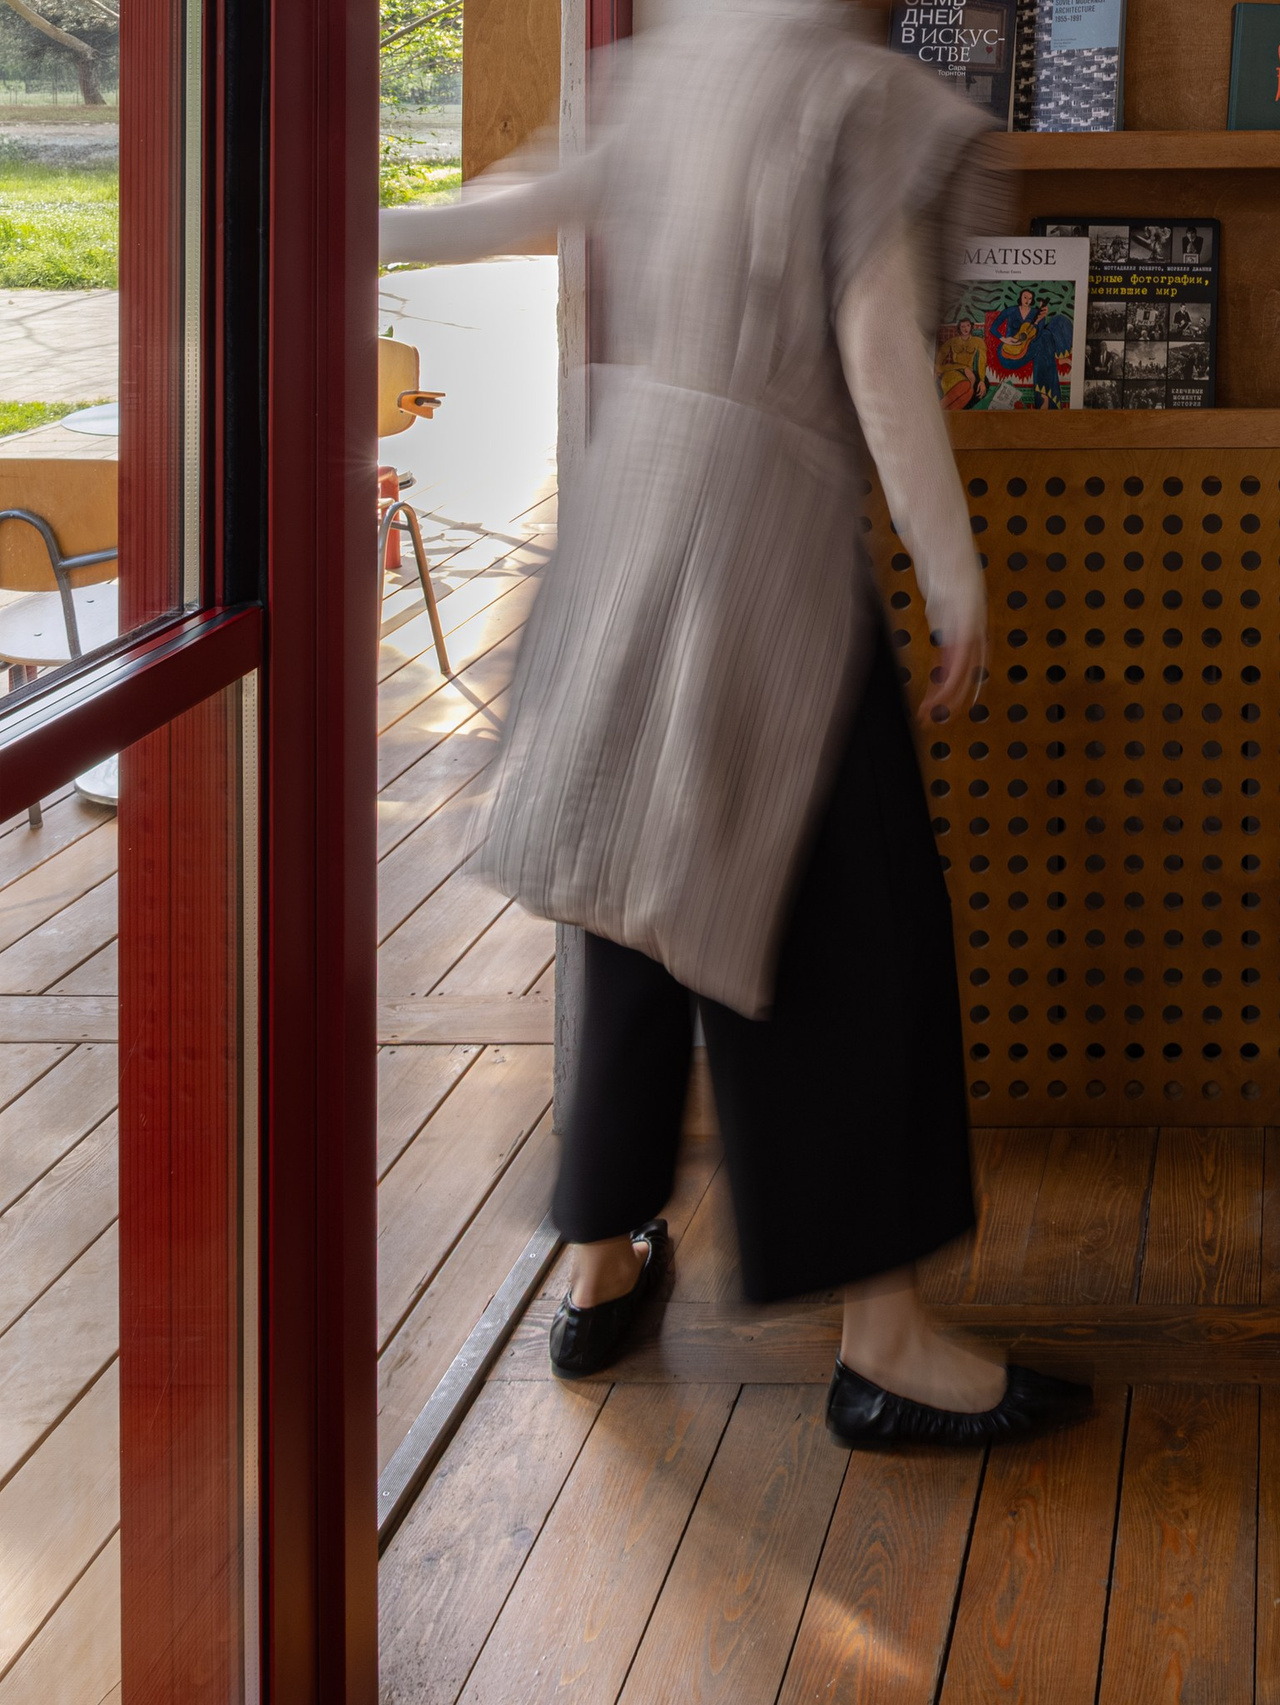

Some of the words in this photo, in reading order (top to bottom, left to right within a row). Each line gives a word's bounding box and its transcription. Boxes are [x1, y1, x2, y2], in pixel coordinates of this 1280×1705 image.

[1055, 5, 1096, 14] ARCHITECTURE
[901, 6, 963, 27] ДНЕЙ
[901, 28, 915, 44] В
[920, 27, 1006, 47] ИСКУС-
[918, 46, 971, 62] СТВЕ
[938, 69, 966, 77] Торнтон
[948, 64, 966, 72] Сара
[963, 247, 1057, 266] MATISSE
[1089, 274, 1123, 285] арные
[1130, 273, 1209, 286] фотографии,
[1088, 287, 1148, 296] менившие
[1156, 287, 1178, 297] мир
